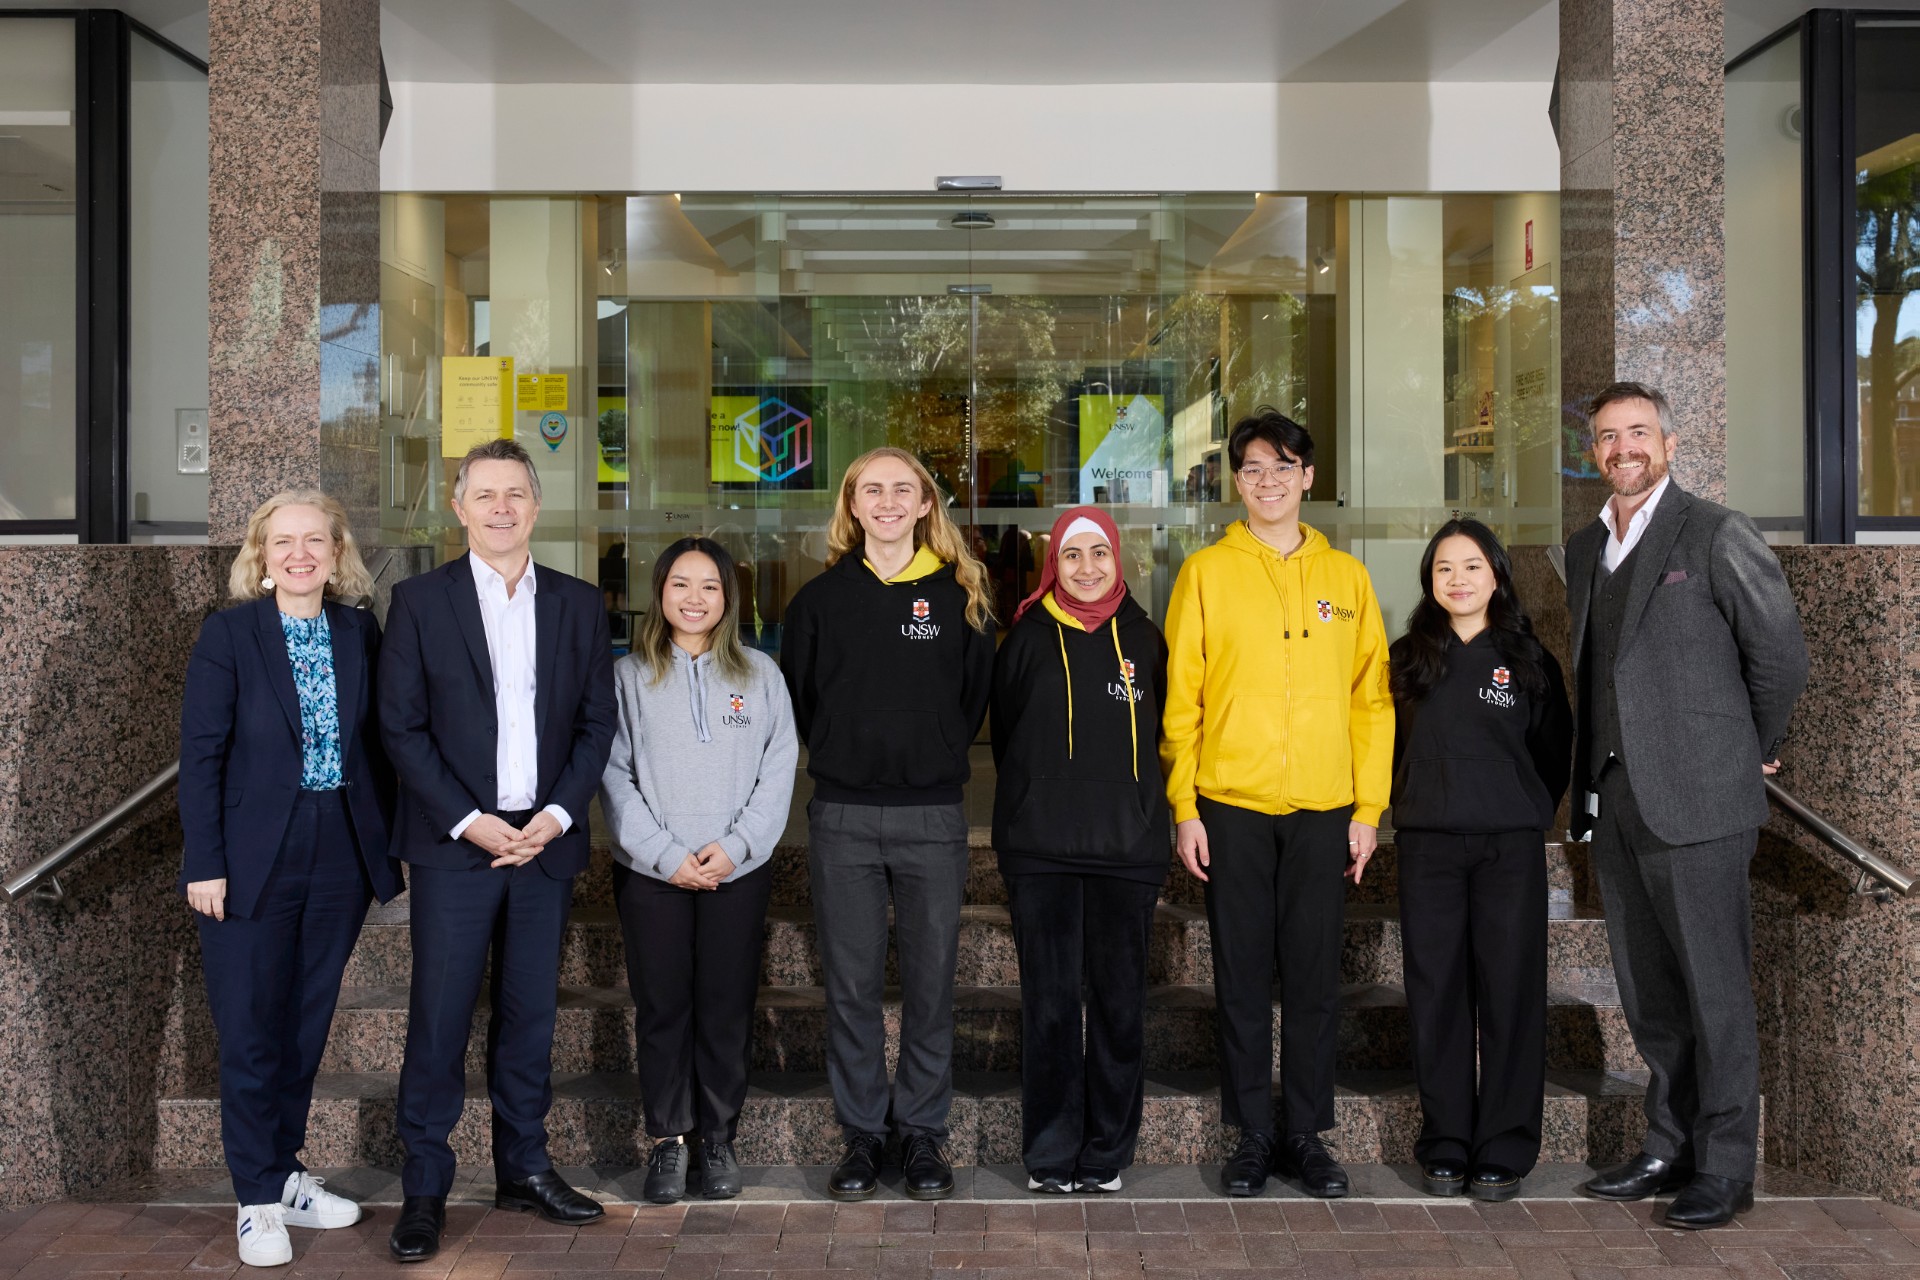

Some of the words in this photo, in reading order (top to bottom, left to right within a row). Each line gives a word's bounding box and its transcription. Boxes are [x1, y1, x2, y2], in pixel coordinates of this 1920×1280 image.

[718, 422, 741, 431] now!
[1109, 423, 1135, 431] UNSW
[1091, 467, 1153, 479] Welcome
[1331, 605, 1356, 620] UNSW
[901, 623, 941, 637] UNSW
[1107, 682, 1144, 701] UNW
[1479, 687, 1517, 706] UNSW
[722, 714, 752, 726] UNSW
